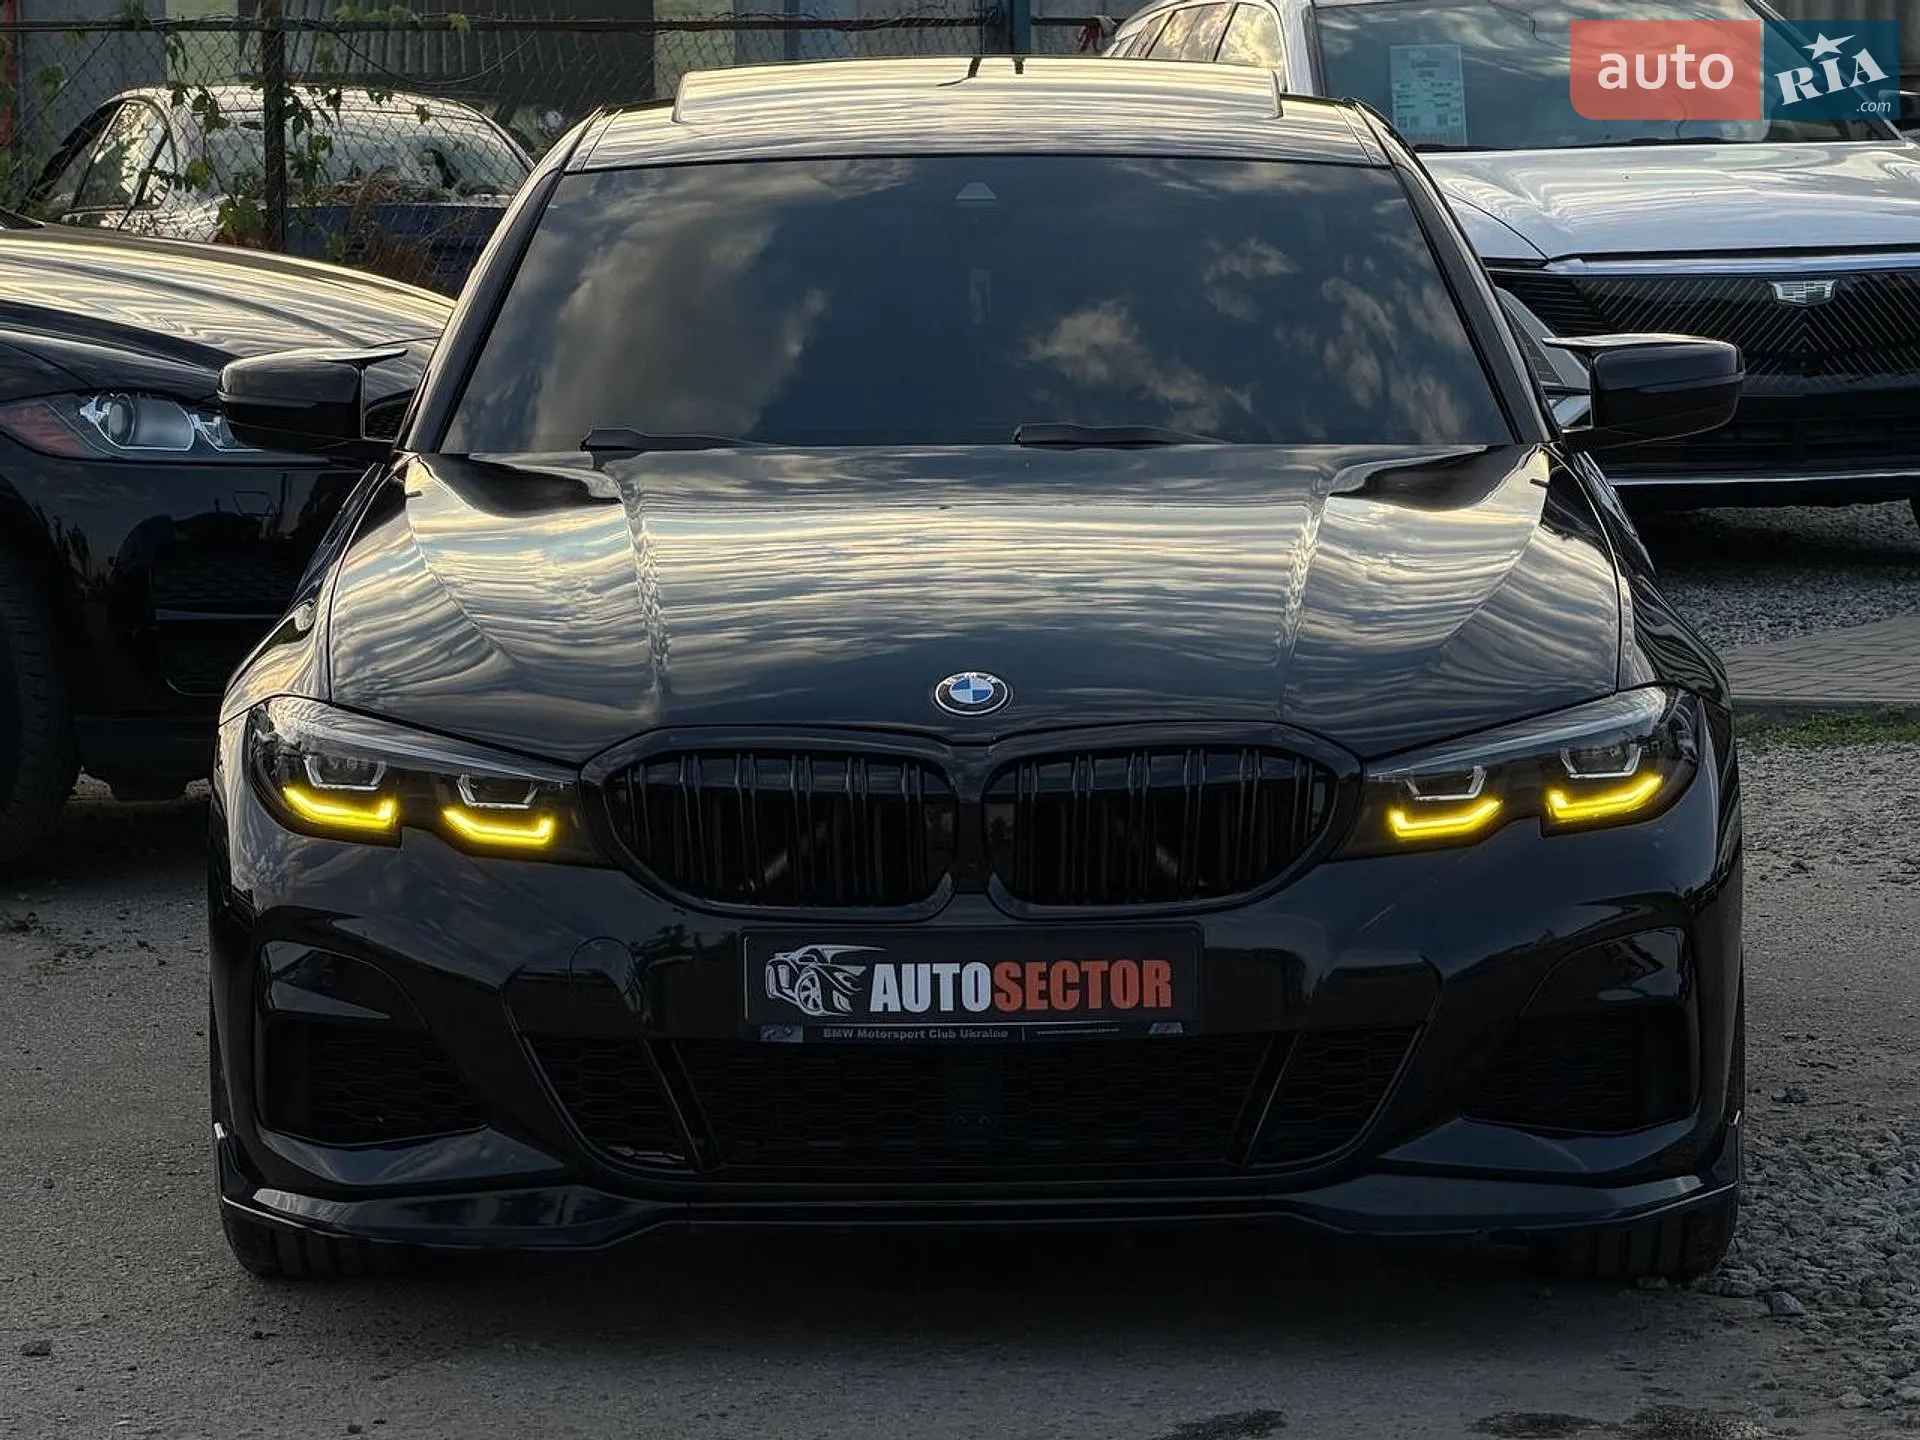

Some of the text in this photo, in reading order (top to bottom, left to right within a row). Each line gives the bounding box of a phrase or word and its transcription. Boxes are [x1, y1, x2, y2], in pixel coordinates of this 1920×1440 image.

[869, 960, 1172, 1012] AUTOSECTOR
[823, 1028, 1008, 1040] BMW Motorsport Club Ukraine
